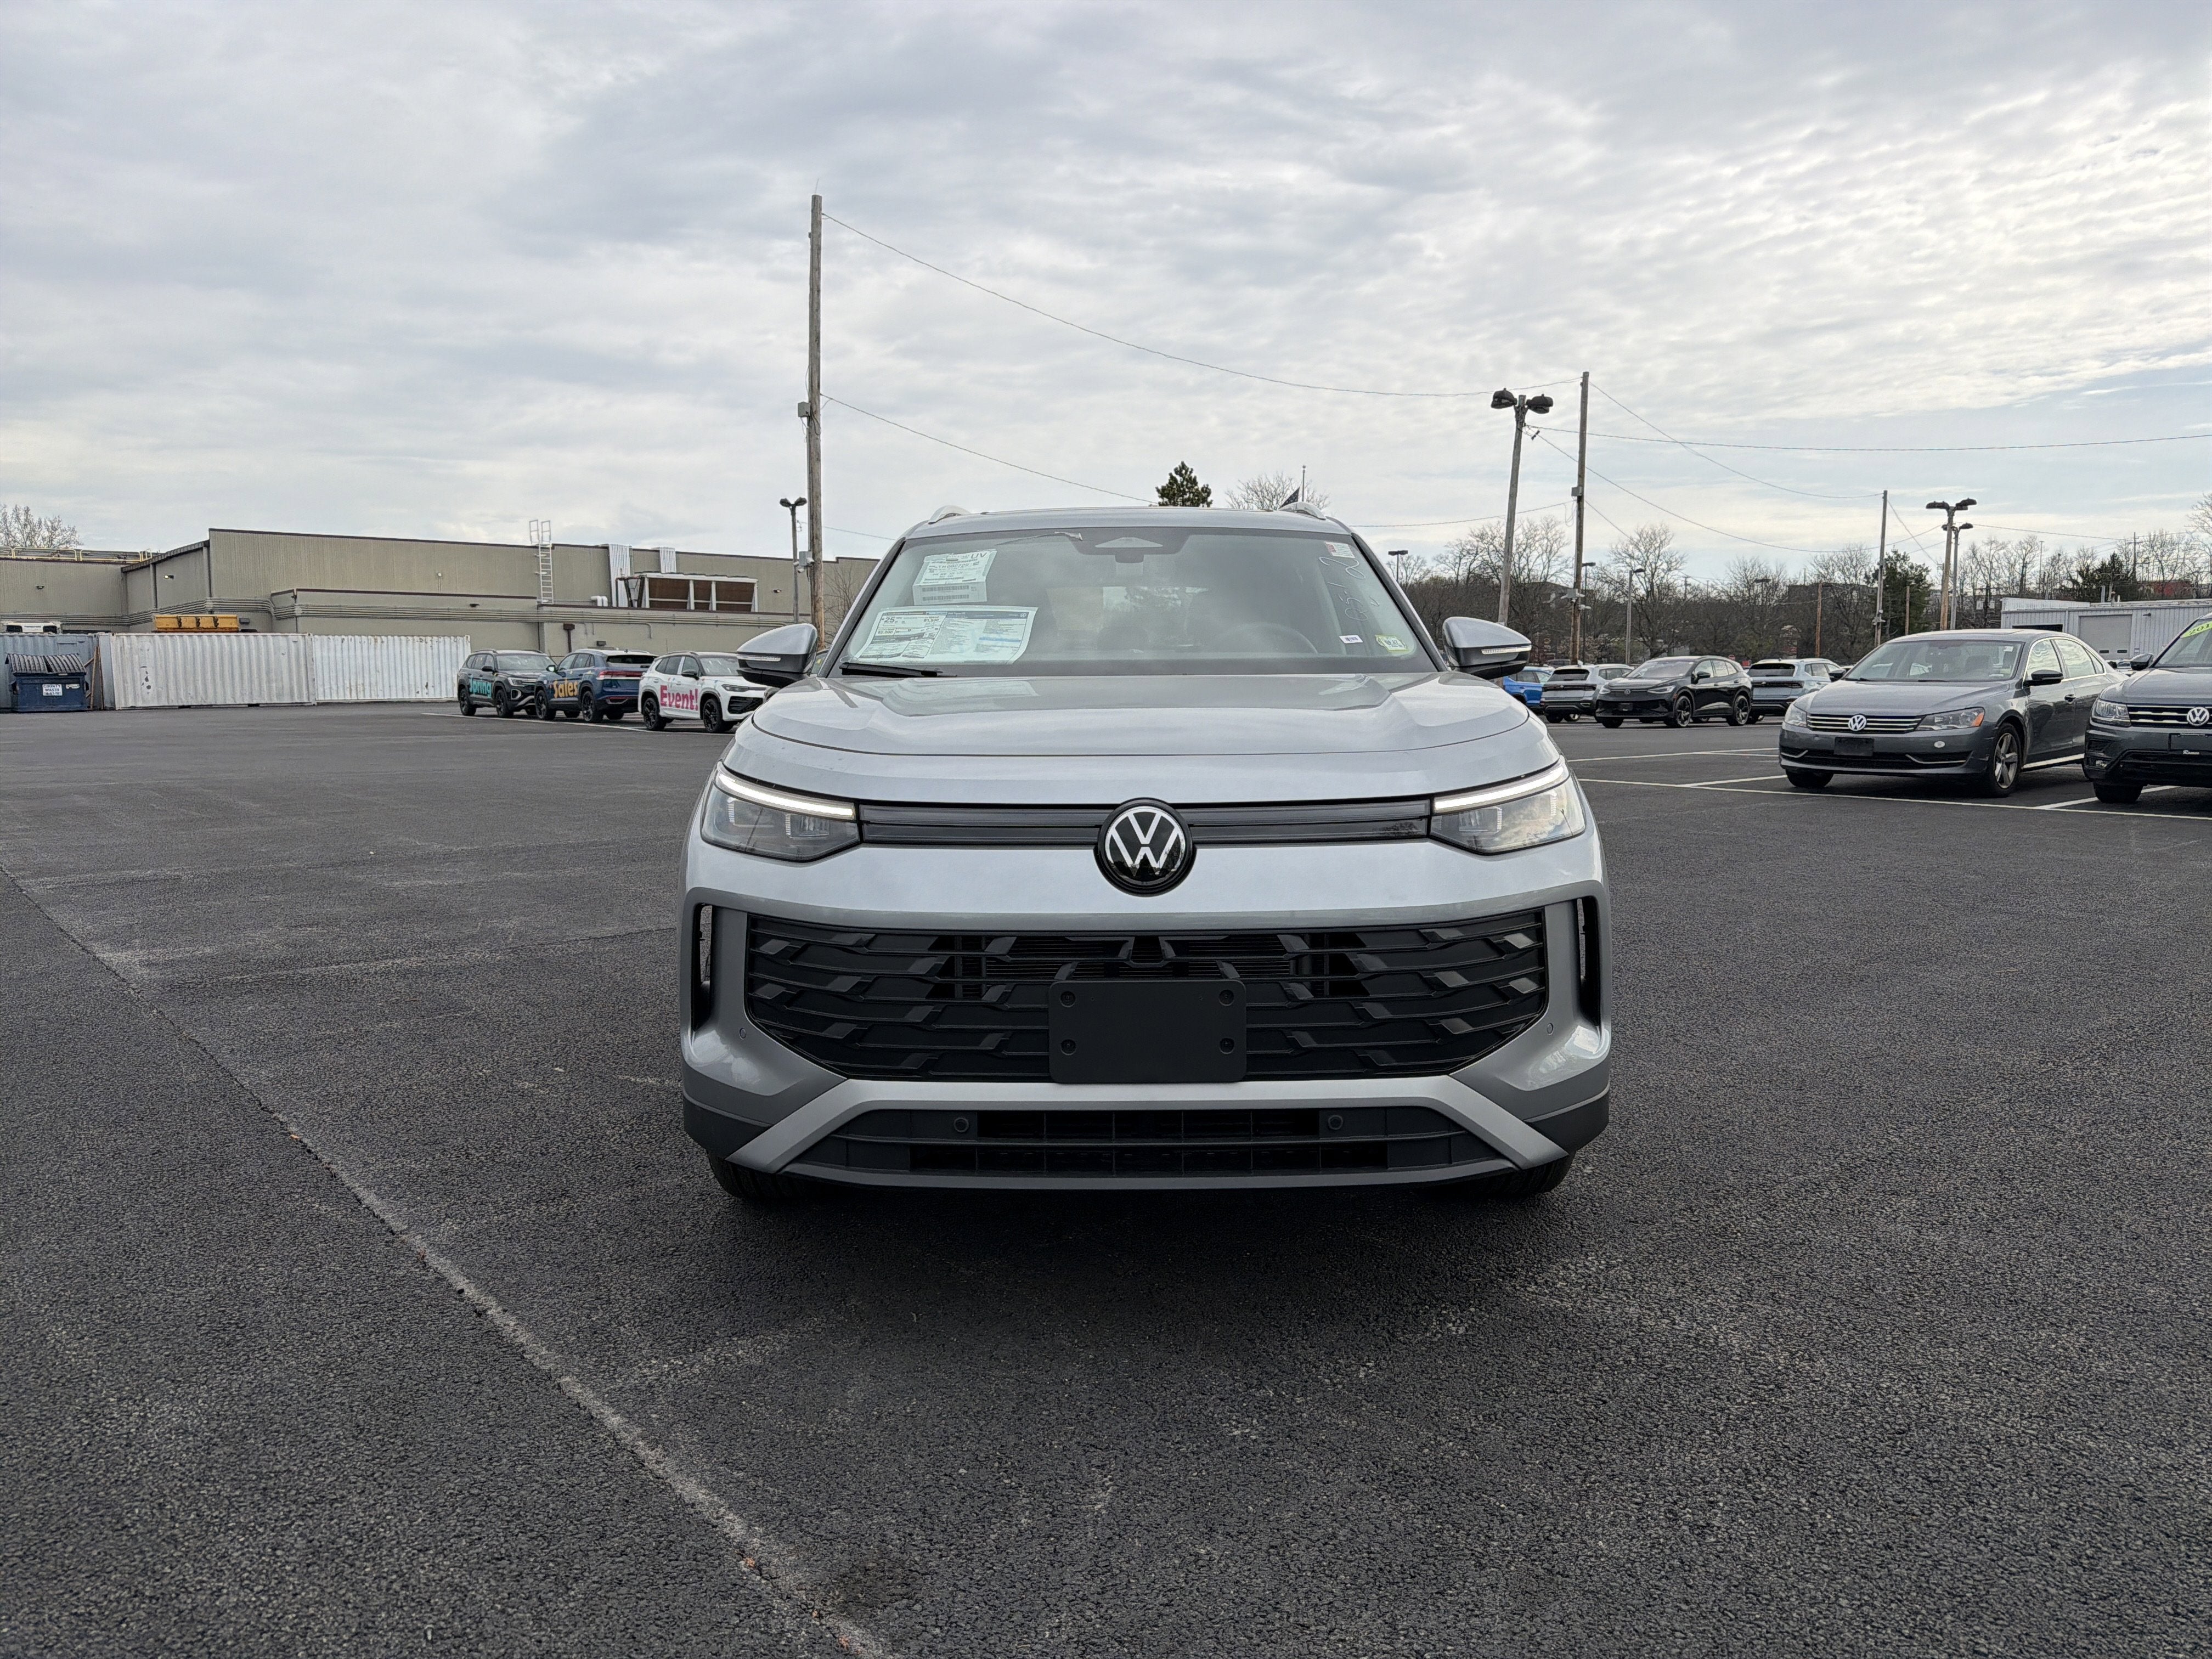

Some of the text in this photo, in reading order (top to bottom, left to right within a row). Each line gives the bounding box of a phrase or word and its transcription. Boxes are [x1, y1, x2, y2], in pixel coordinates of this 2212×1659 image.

[469, 675, 492, 698] Spring
[553, 678, 578, 698] Sales
[660, 685, 698, 711] Event!
[1848, 715, 1866, 731] VW
[2187, 707, 2210, 726] VW
[1105, 805, 1186, 882] VW
